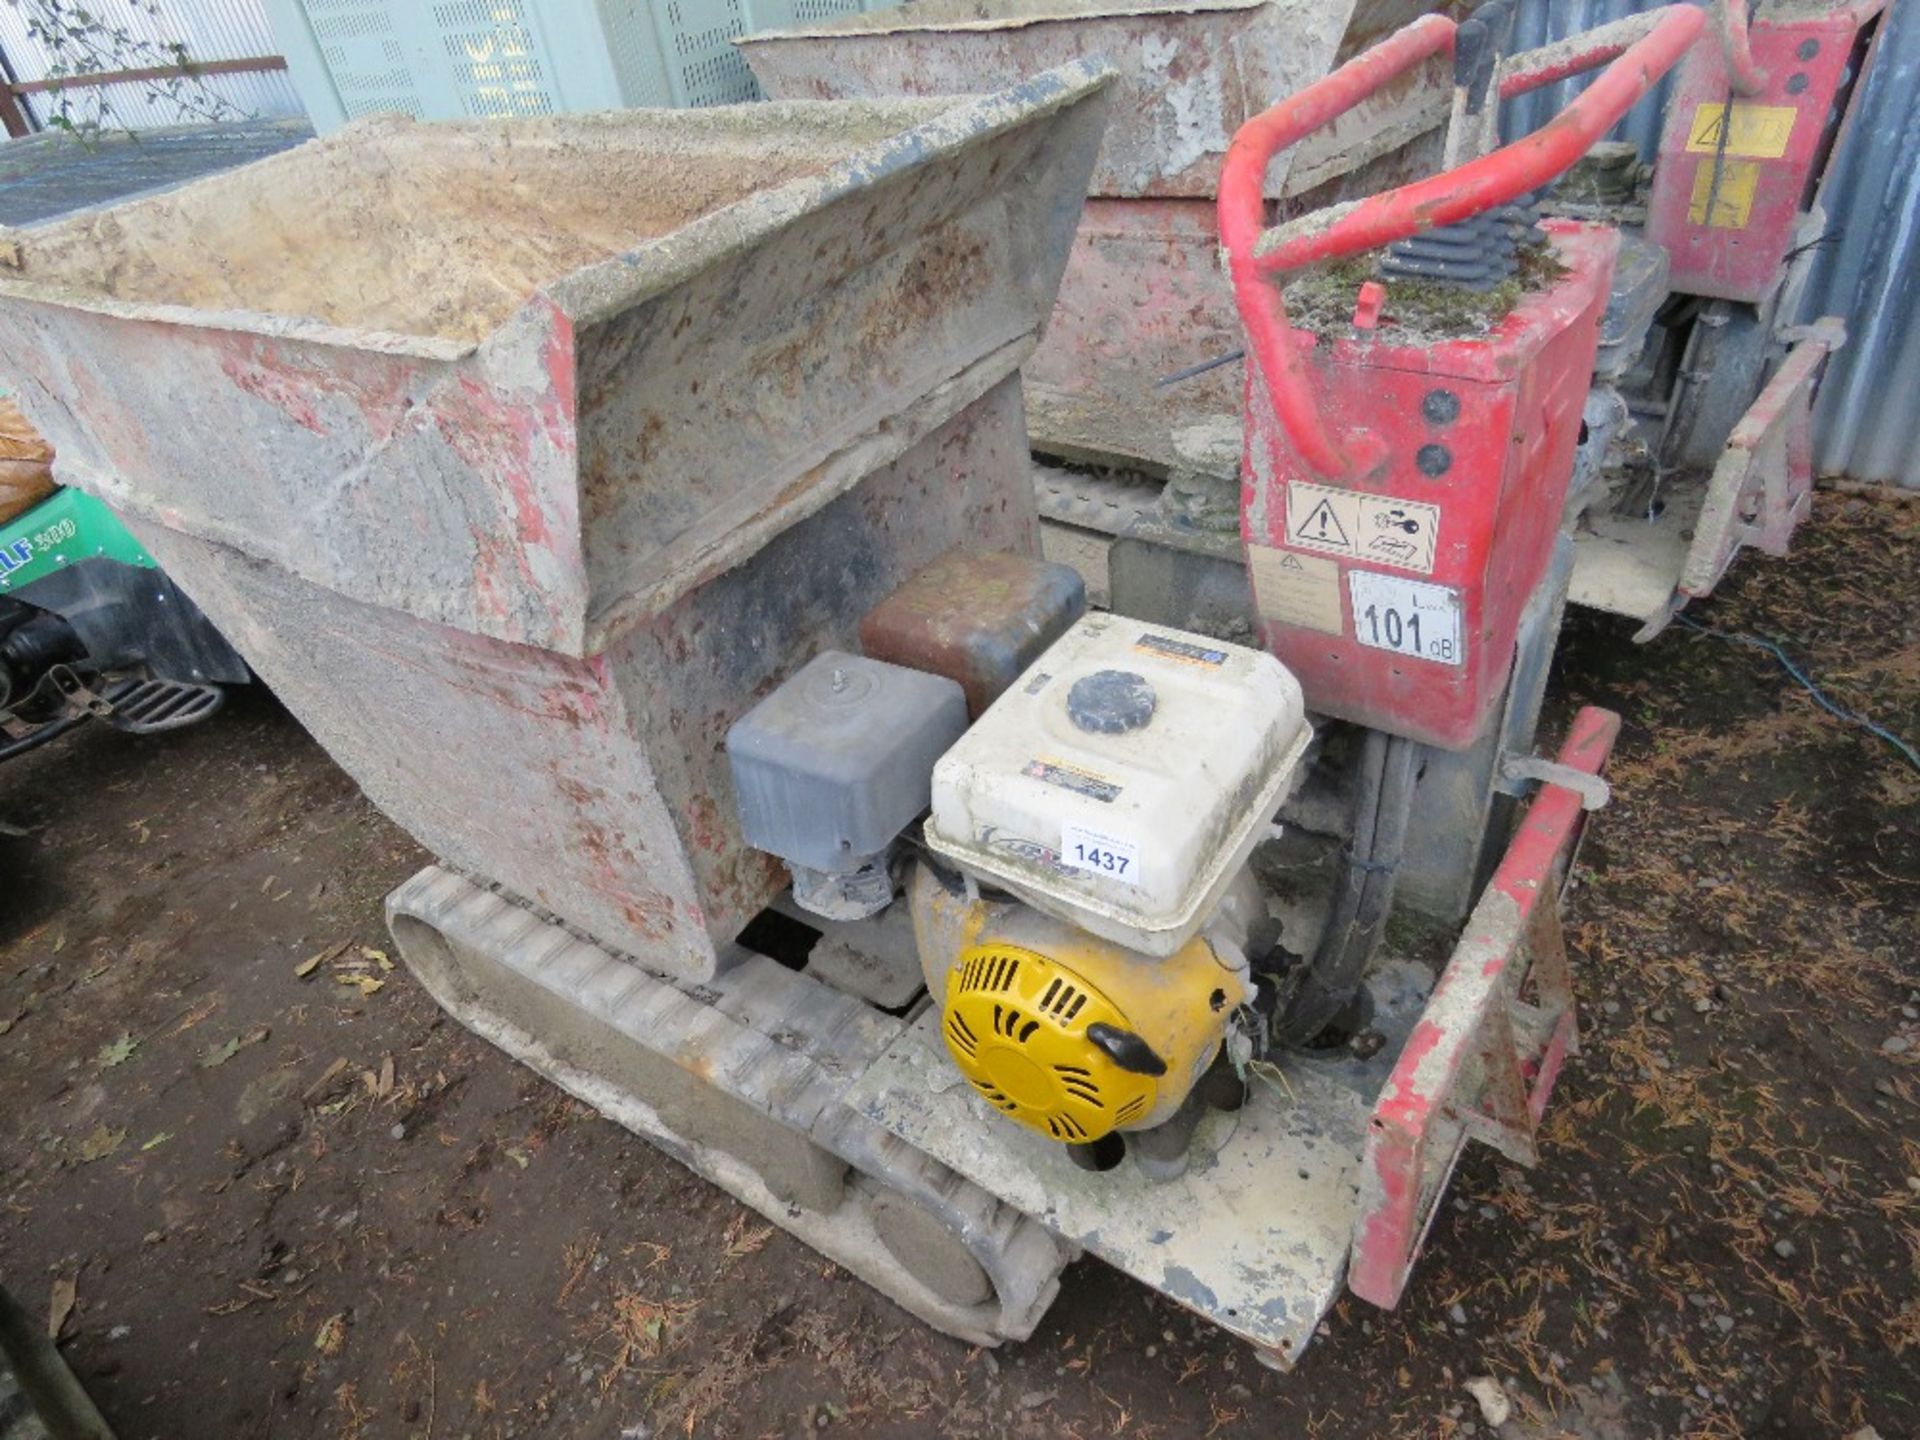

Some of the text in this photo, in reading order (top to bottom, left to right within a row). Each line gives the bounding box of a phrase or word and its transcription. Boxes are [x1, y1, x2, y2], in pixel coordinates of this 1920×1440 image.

[0, 537, 34, 578] LF
[1365, 604, 1422, 653] 101
[1075, 844, 1130, 875] 1437
